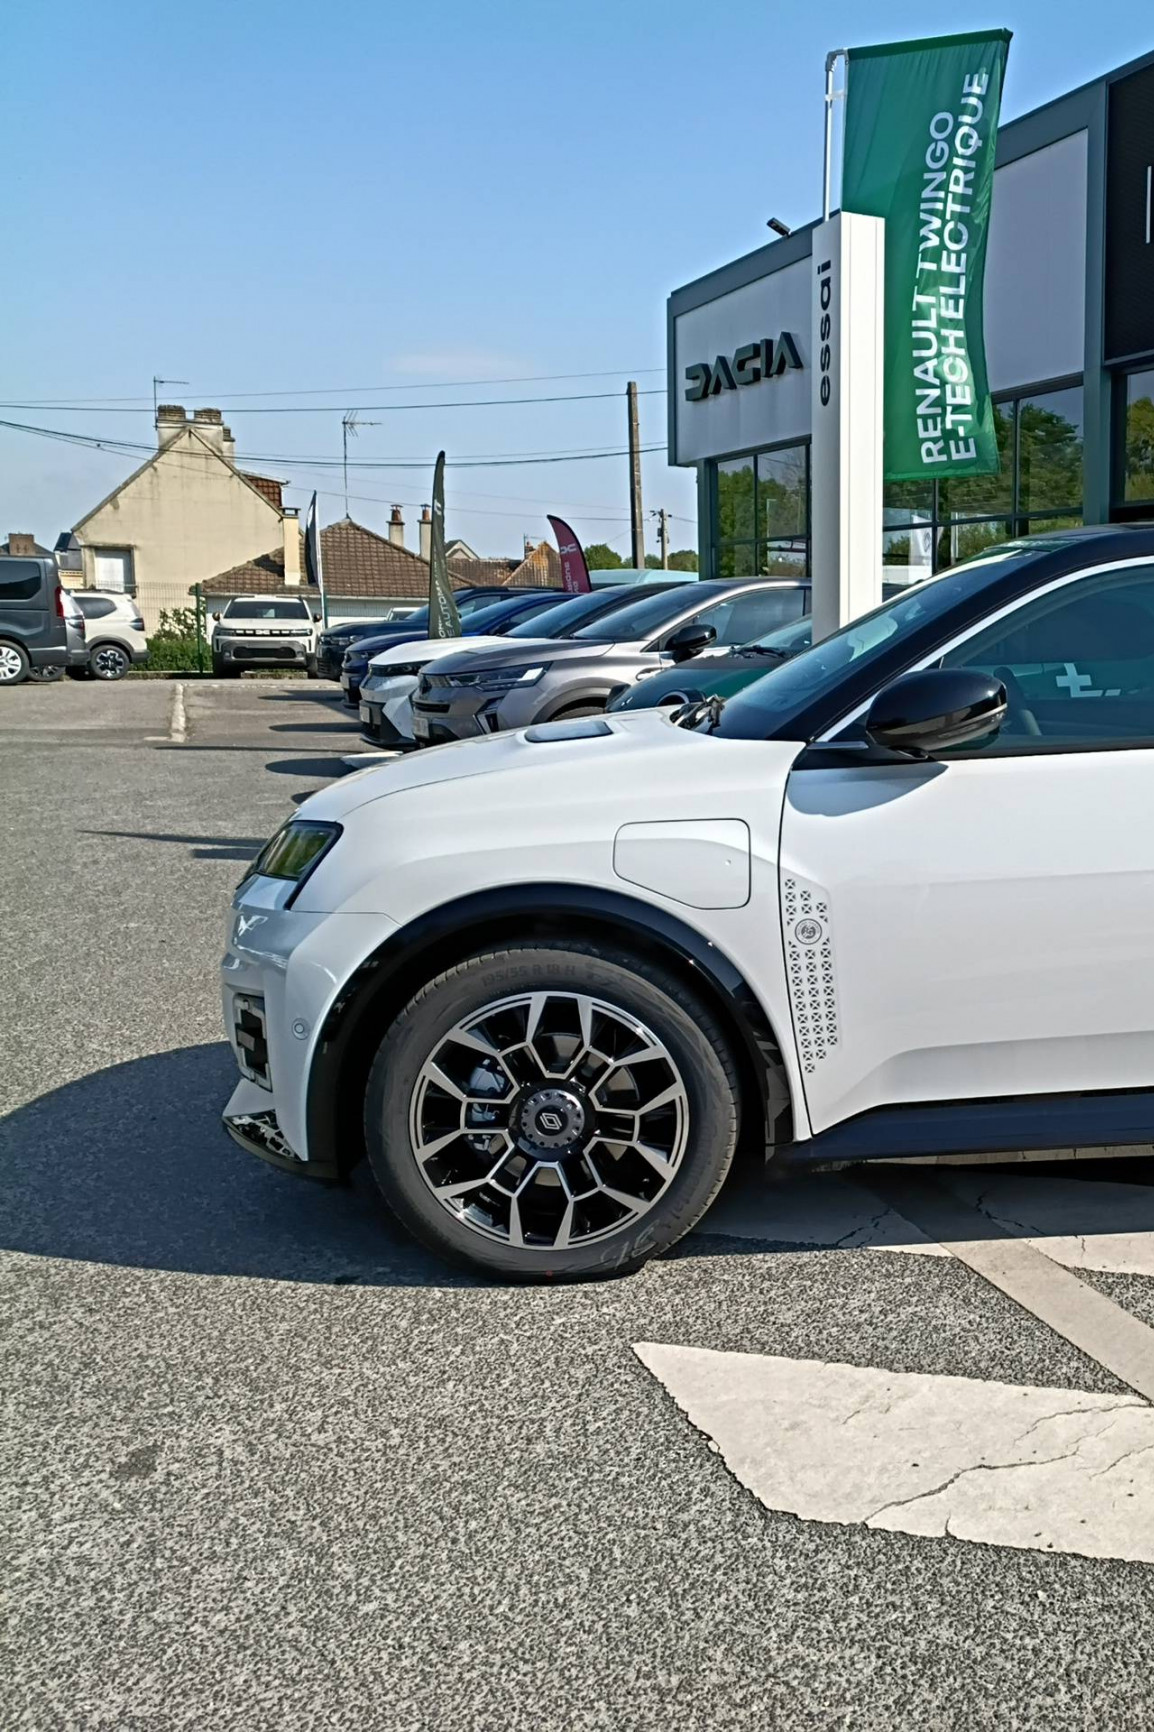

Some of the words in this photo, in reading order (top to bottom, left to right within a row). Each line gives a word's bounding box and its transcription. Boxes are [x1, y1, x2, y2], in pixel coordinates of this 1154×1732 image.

[916, 111, 954, 279] TWINGO
[938, 72, 989, 320] ELECTRIQUE
[685, 331, 804, 401] DACIA
[817, 259, 832, 407] essai
[912, 286, 948, 464] RENAULT
[941, 328, 977, 461] E-TECH
[532, 963, 542, 975] R
